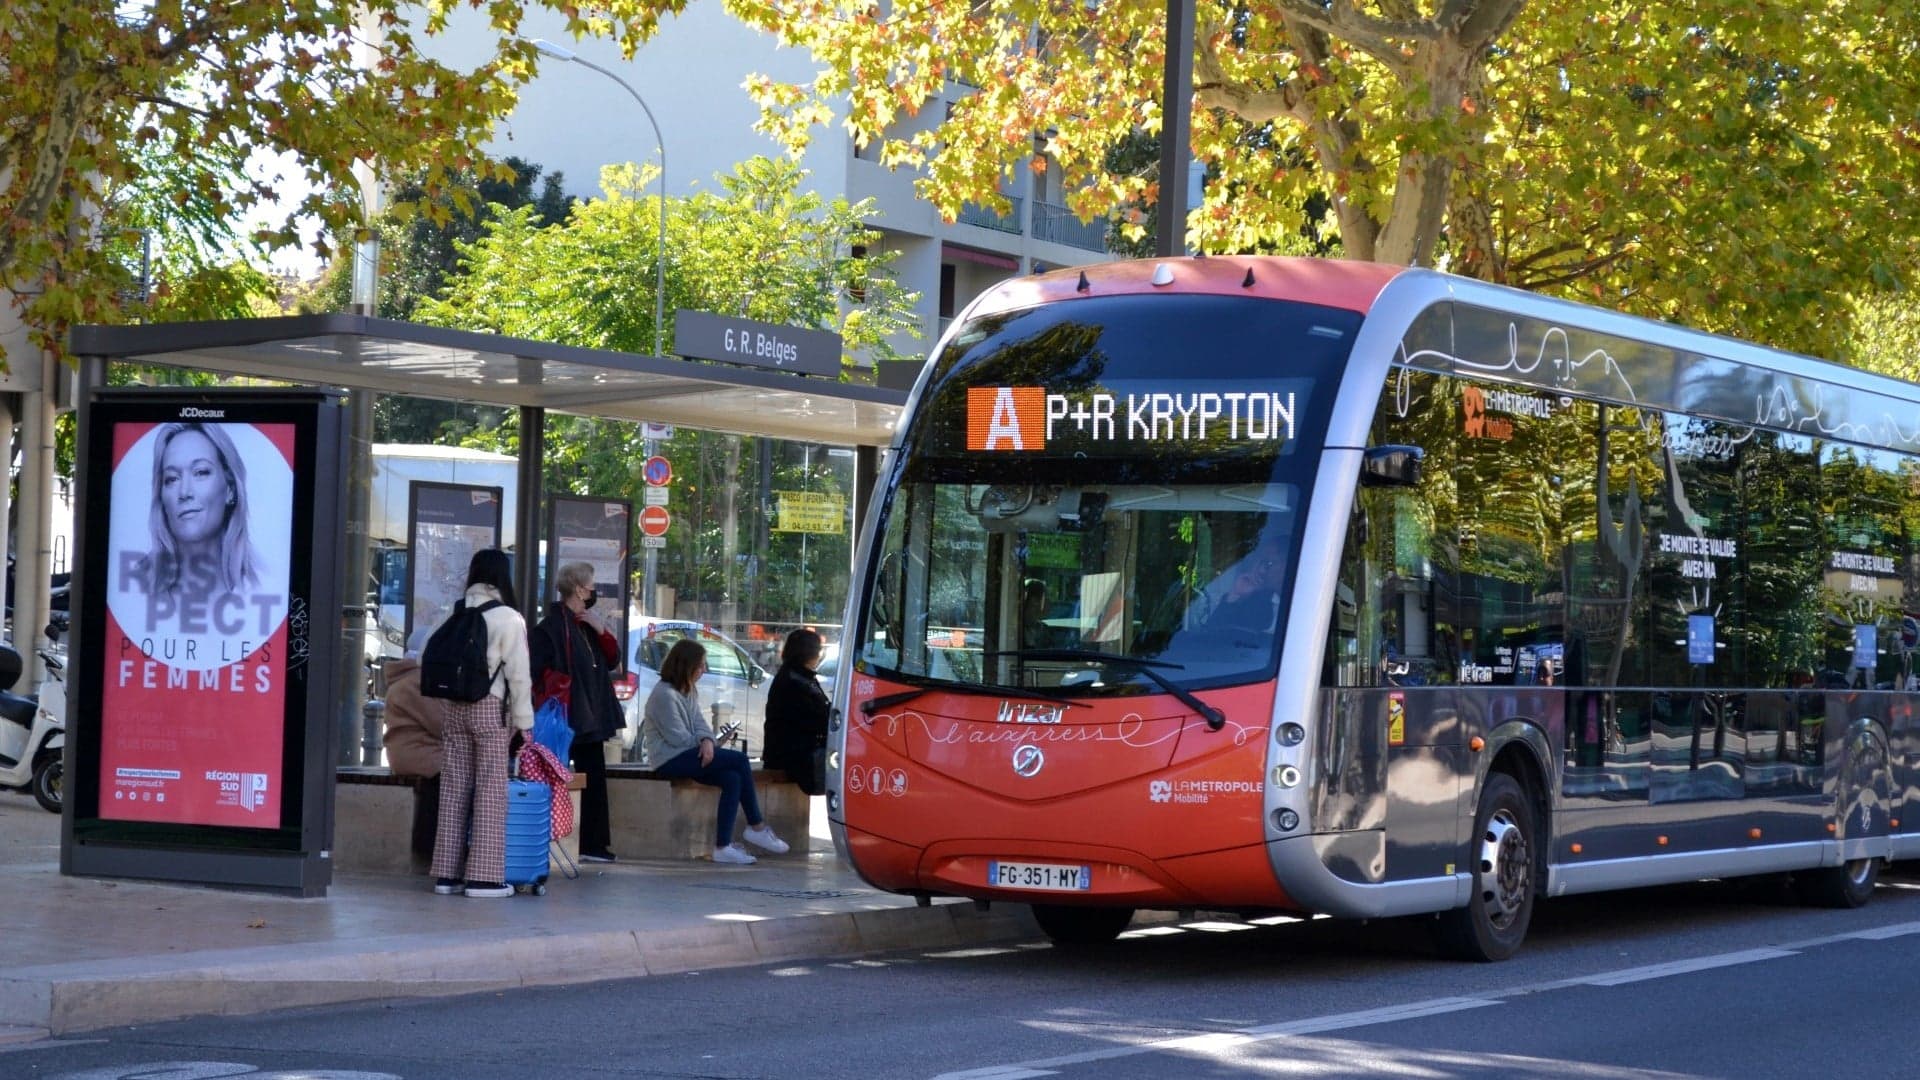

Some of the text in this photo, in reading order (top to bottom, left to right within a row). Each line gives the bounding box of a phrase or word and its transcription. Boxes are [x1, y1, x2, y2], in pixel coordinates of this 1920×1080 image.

[724, 328, 798, 365] G. R. Belges
[179, 407, 225, 418] JCDecaux
[985, 387, 1024, 450] A
[1046, 392, 1296, 440] P+R KRYPTON
[1659, 533, 1737, 558] JE MONTE JE VALIDE
[1682, 559, 1704, 578] AVEC
[145, 592, 282, 636] PECT
[120, 637, 272, 663] POUR LES
[119, 660, 271, 693] FEMMES
[220, 782, 240, 792] SUD
[998, 864, 1079, 888] FG-351-MY
